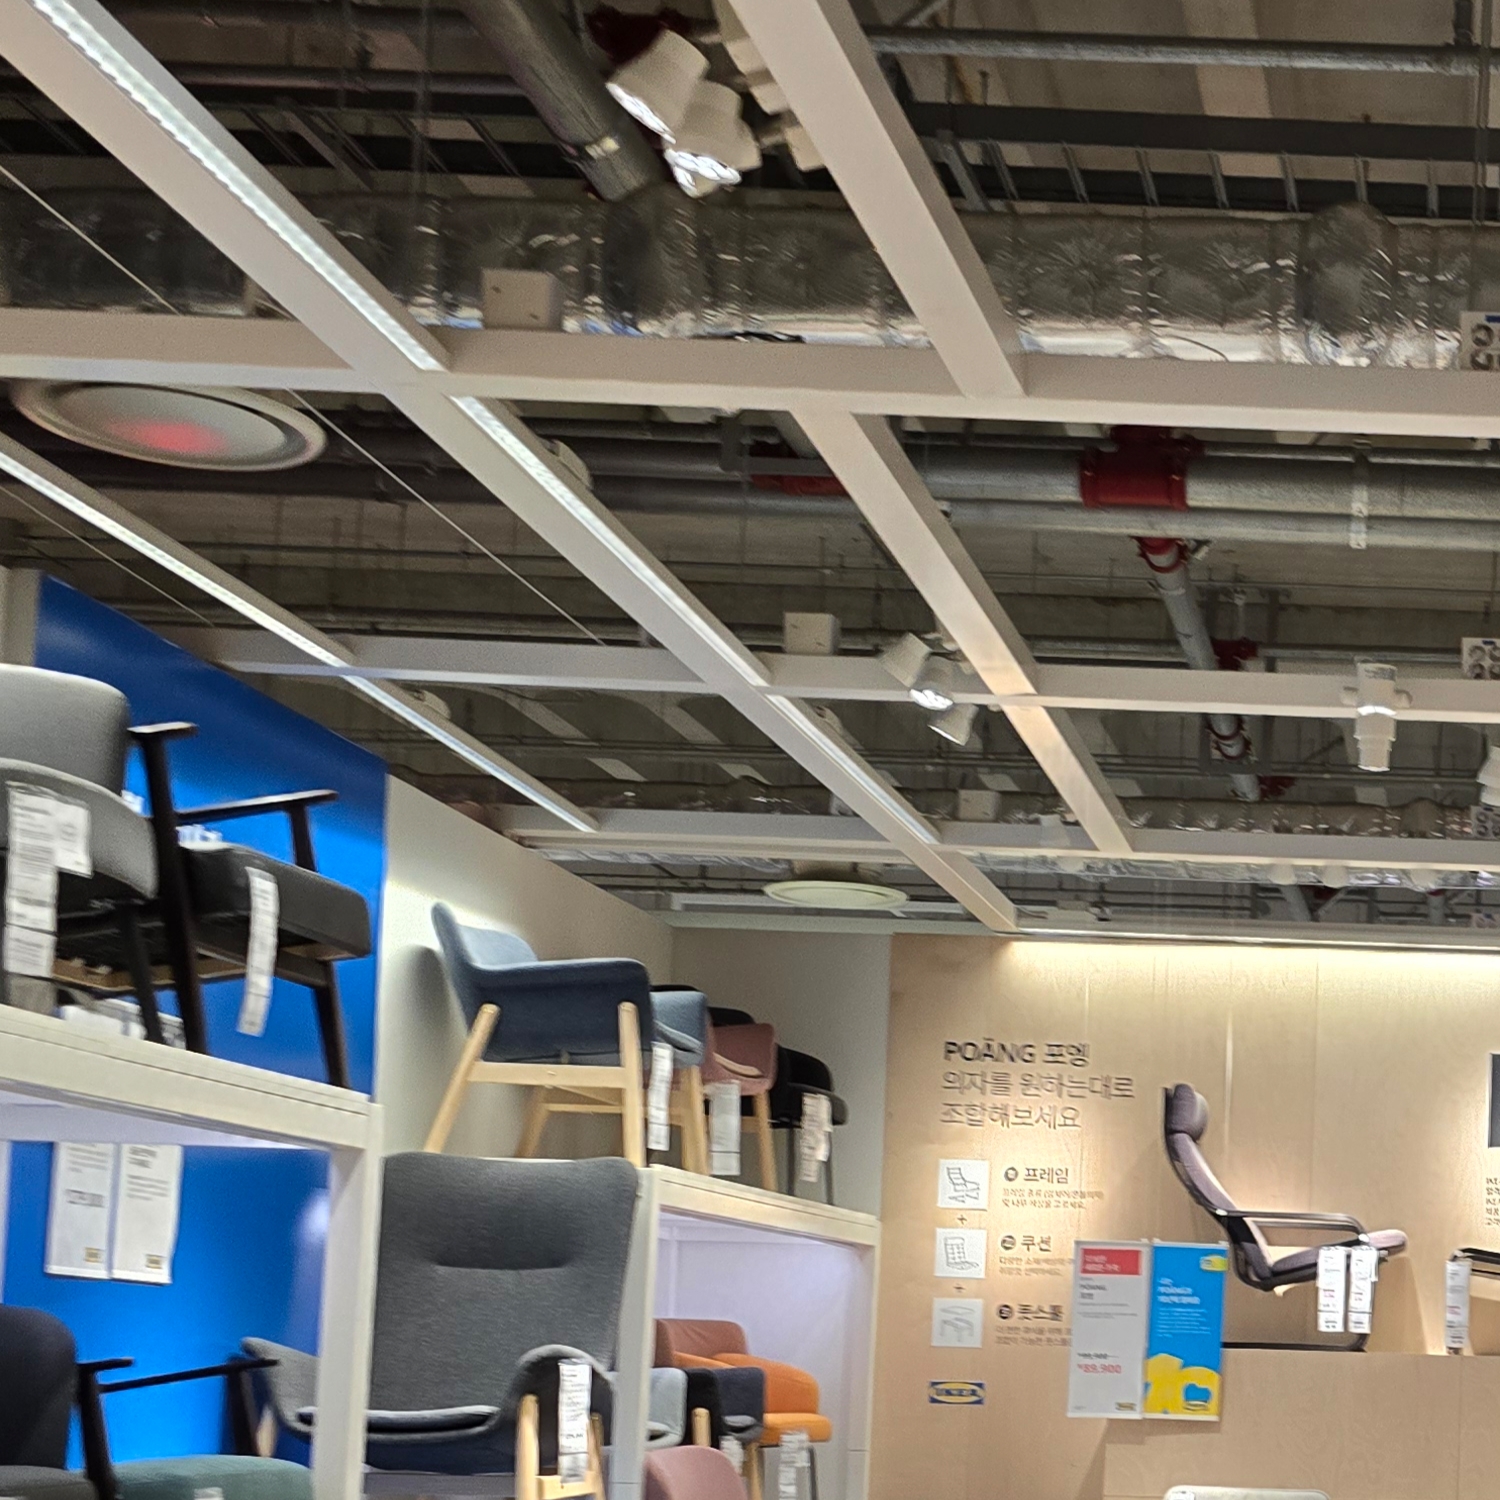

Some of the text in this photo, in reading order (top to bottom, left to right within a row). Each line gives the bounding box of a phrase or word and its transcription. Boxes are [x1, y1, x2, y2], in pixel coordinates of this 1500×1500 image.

[944, 1037, 1090, 1067] POÄNG 포엥
[942, 1071, 1135, 1099] 의자를 원하는대로
[940, 1102, 1082, 1129] 조합해보세요
[1024, 1167, 1069, 1184] 프레임
[1021, 1235, 1051, 1252] 쿠션
